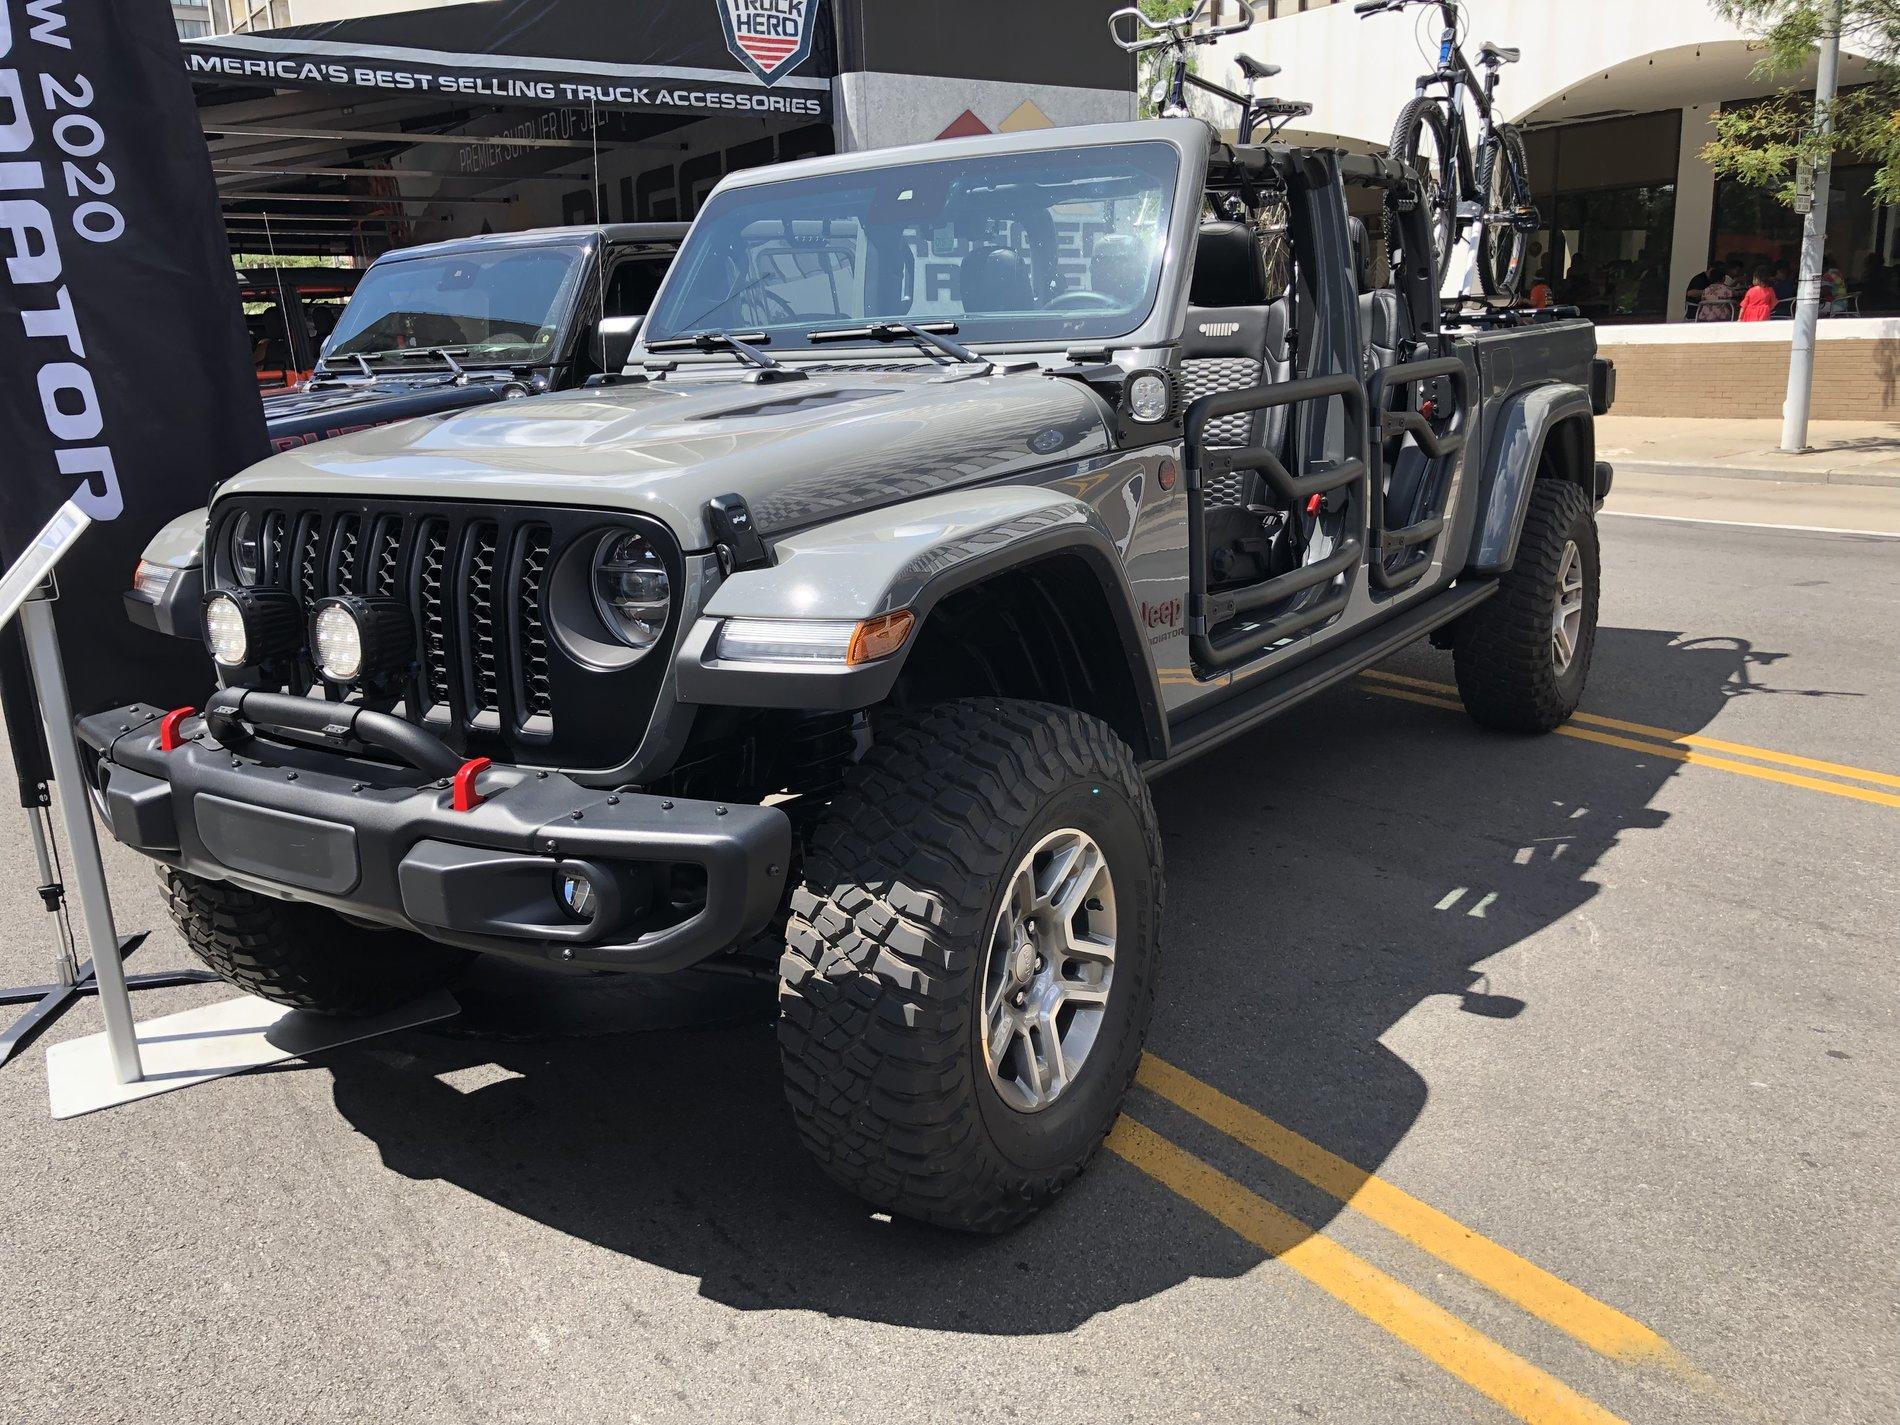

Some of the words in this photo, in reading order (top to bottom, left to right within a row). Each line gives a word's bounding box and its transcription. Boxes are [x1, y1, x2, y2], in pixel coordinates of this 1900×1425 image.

[736, 12, 799, 37] HERO
[354, 68, 433, 90] BEST
[438, 75, 556, 100] SELLING
[559, 83, 651, 104] TRUCK
[655, 89, 821, 115] ACCESSORIES
[38, 73, 126, 243] 2020
[459, 134, 503, 173] PREMIER
[560, 107, 577, 139] OF
